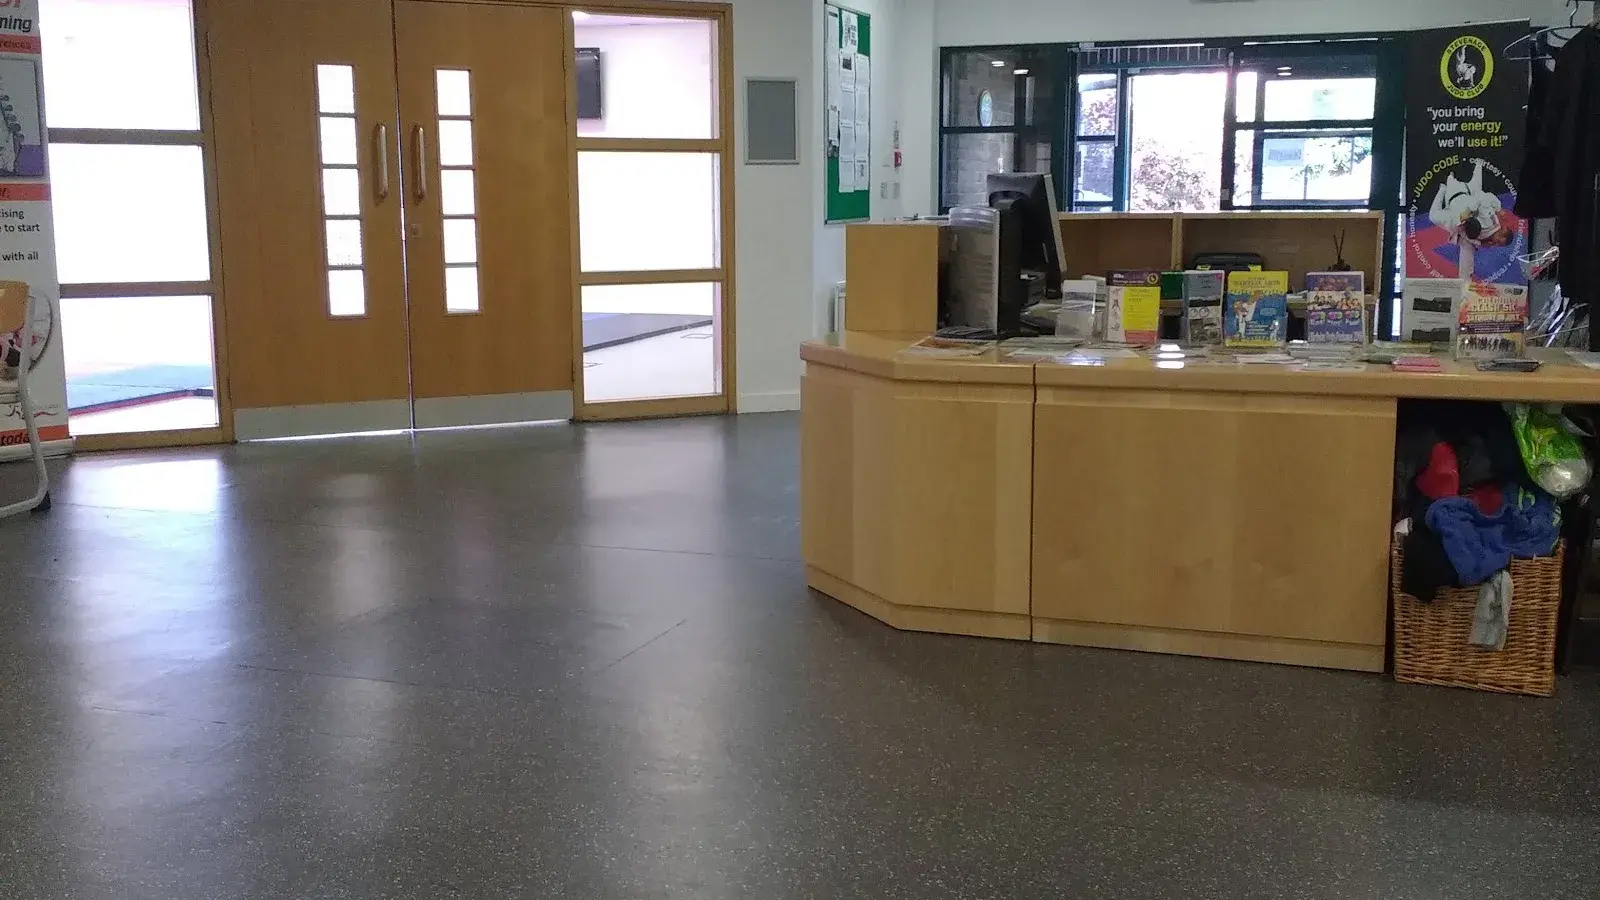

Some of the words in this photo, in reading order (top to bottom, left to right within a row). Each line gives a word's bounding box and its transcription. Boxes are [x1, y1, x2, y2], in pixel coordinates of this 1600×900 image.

[1446, 37, 1485, 55] STEVENAGE
[1447, 84, 1465, 97] JUDO
[1466, 83, 1485, 97] CLUB
[1454, 105, 1485, 119] bring
[1432, 122, 1459, 135] your
[1460, 121, 1502, 134] energy
[1438, 136, 1465, 148] we’ll
[1467, 138, 1488, 148] use
[1432, 154, 1460, 173] CODE
[1413, 170, 1433, 198] JUDO
[1409, 203, 1418, 238] honesty
[4, 224, 15, 233] to
[17, 223, 40, 232] start
[2, 251, 25, 261] with
[27, 251, 39, 260] all
[1412, 243, 1431, 269] control
